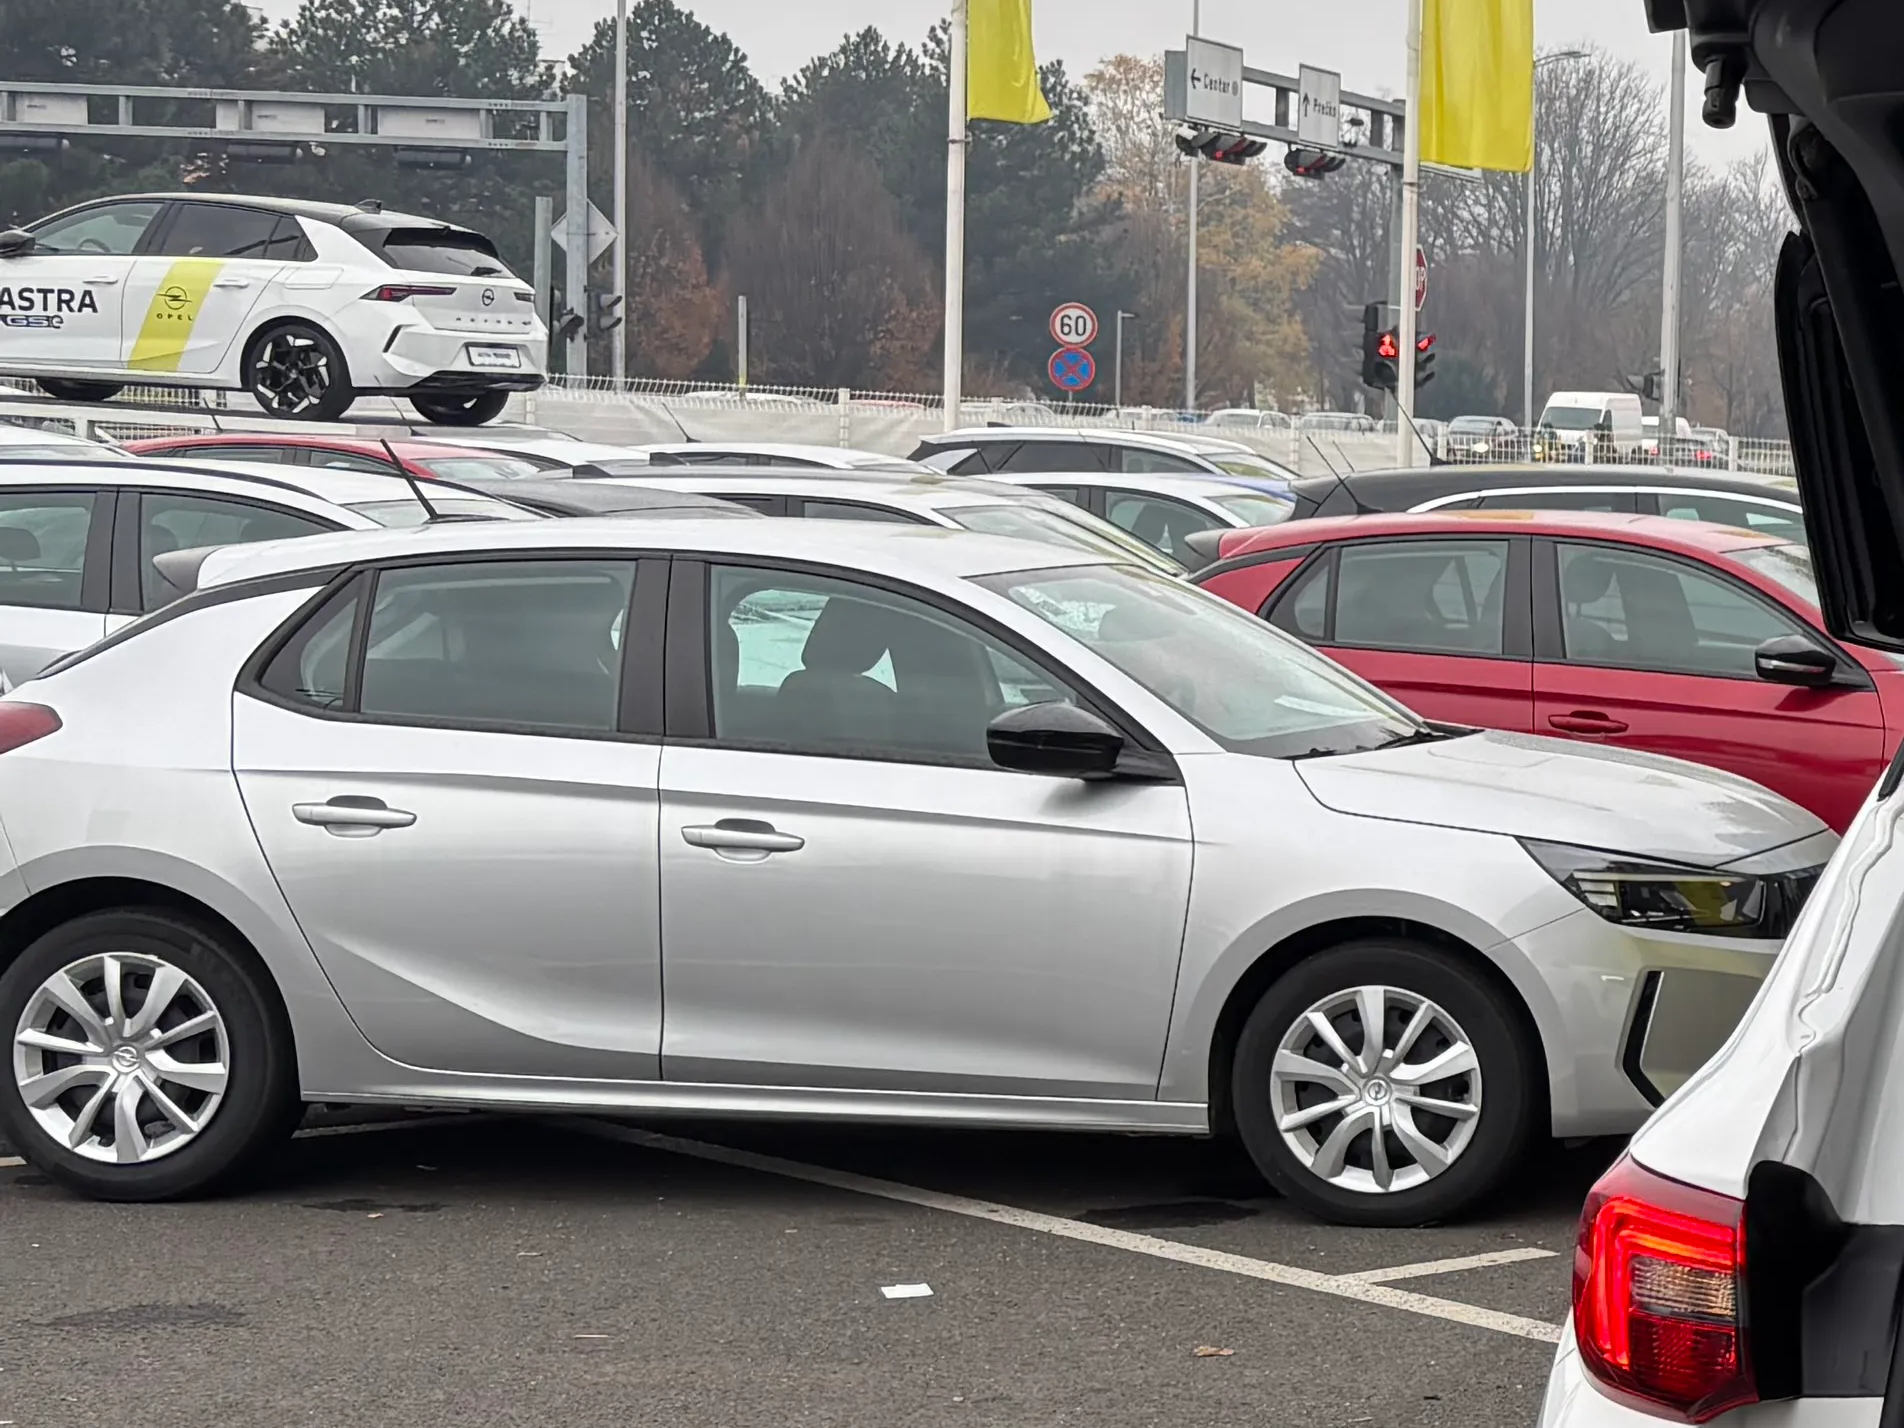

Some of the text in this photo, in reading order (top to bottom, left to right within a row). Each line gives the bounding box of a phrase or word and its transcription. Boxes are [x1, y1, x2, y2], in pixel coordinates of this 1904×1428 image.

[0, 287, 99, 314] ASTRA
[156, 313, 193, 321] OPEL
[1060, 314, 1087, 336] 60
